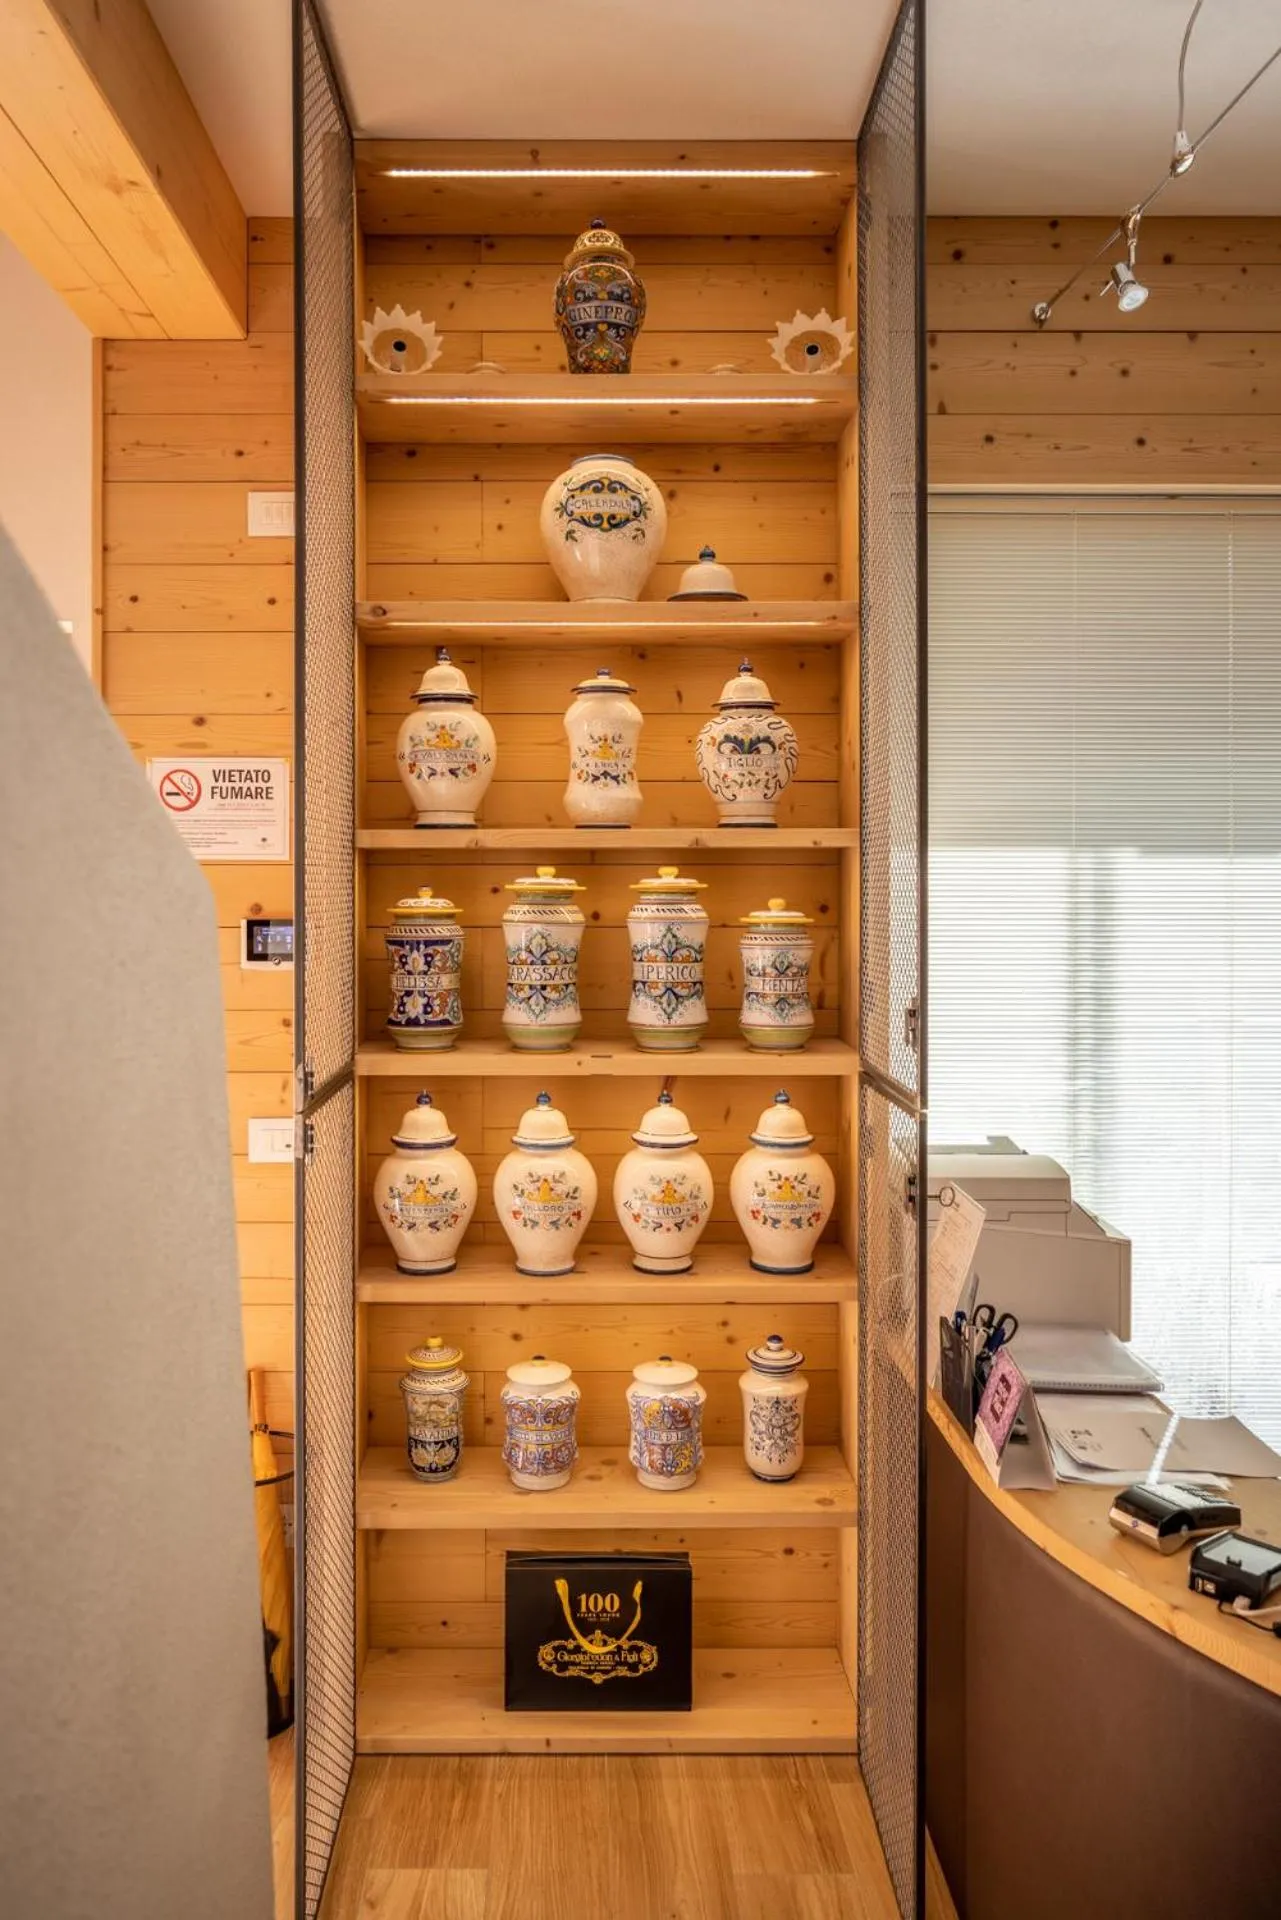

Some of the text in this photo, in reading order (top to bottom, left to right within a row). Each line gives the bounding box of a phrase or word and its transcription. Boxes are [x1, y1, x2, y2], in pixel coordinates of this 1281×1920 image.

[212, 769, 271, 784] VIETATO
[210, 786, 274, 800] FUMARE
[640, 964, 697, 981] IPERICO
[577, 1592, 620, 1613] 100
